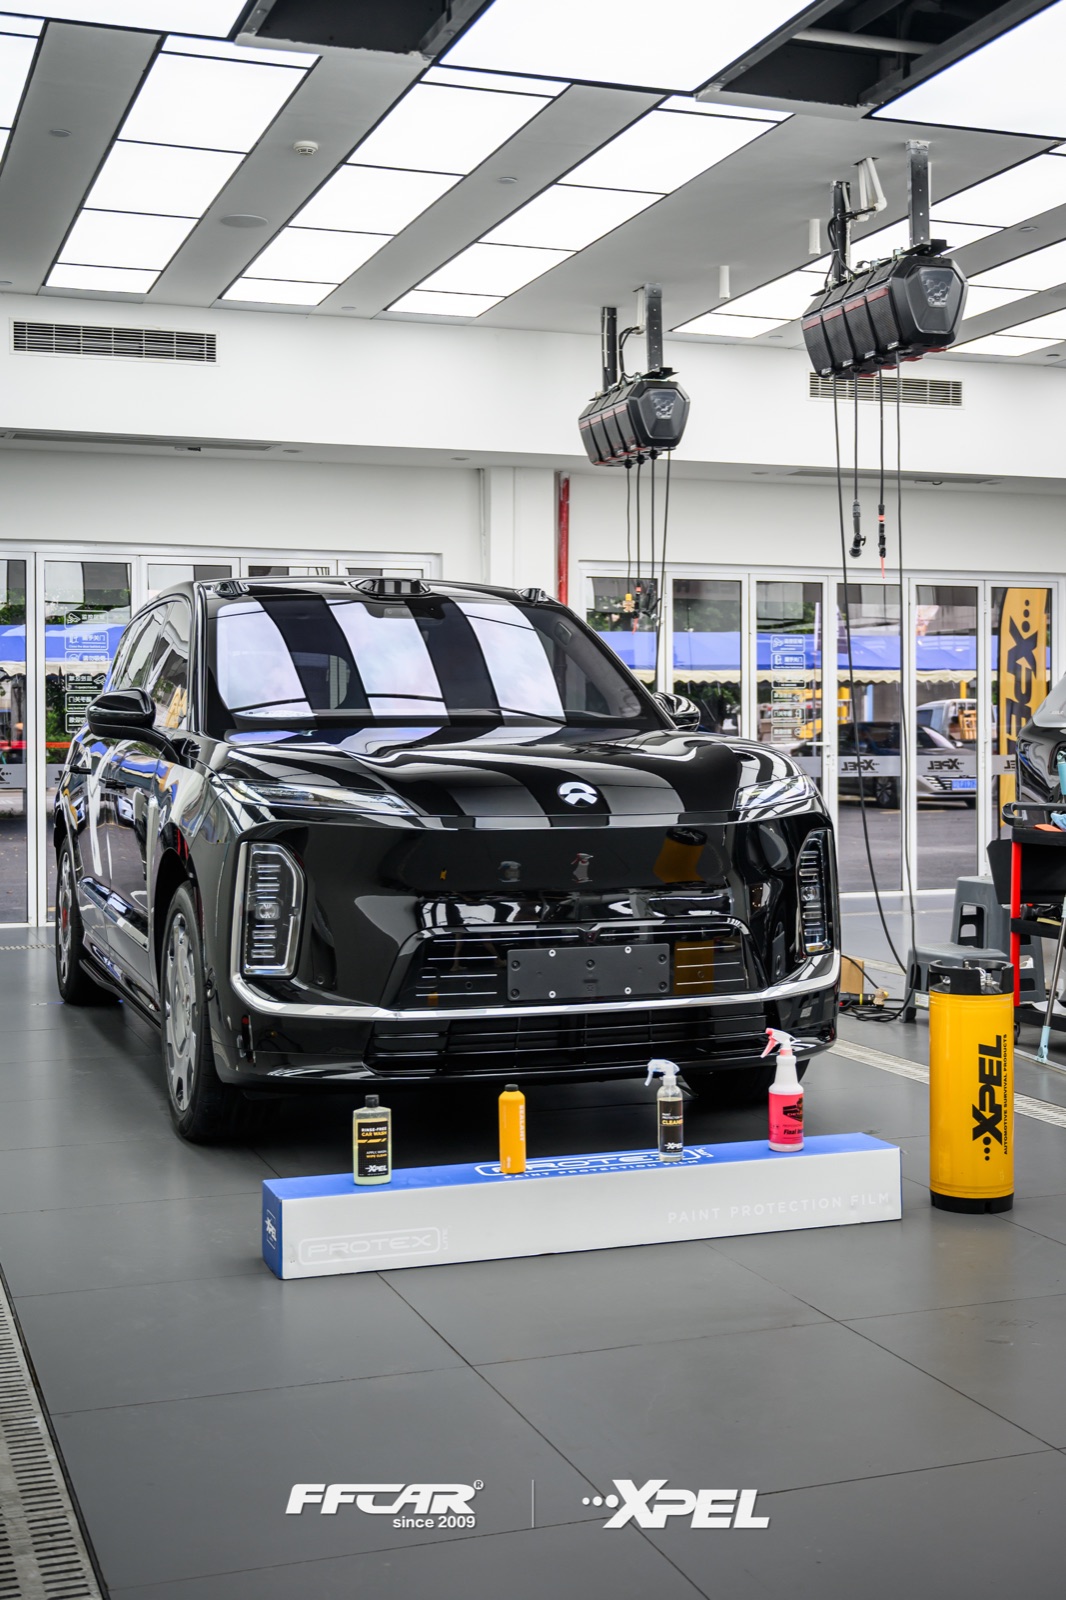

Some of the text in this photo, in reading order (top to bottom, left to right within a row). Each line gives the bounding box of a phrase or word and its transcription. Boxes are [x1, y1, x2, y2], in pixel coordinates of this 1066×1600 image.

[972, 1035, 1002, 1146] XPEL
[491, 1154, 686, 1172] ROTE
[668, 1192, 889, 1223] PAINT PROTECTION FILM
[308, 1234, 431, 1257] PROTEX
